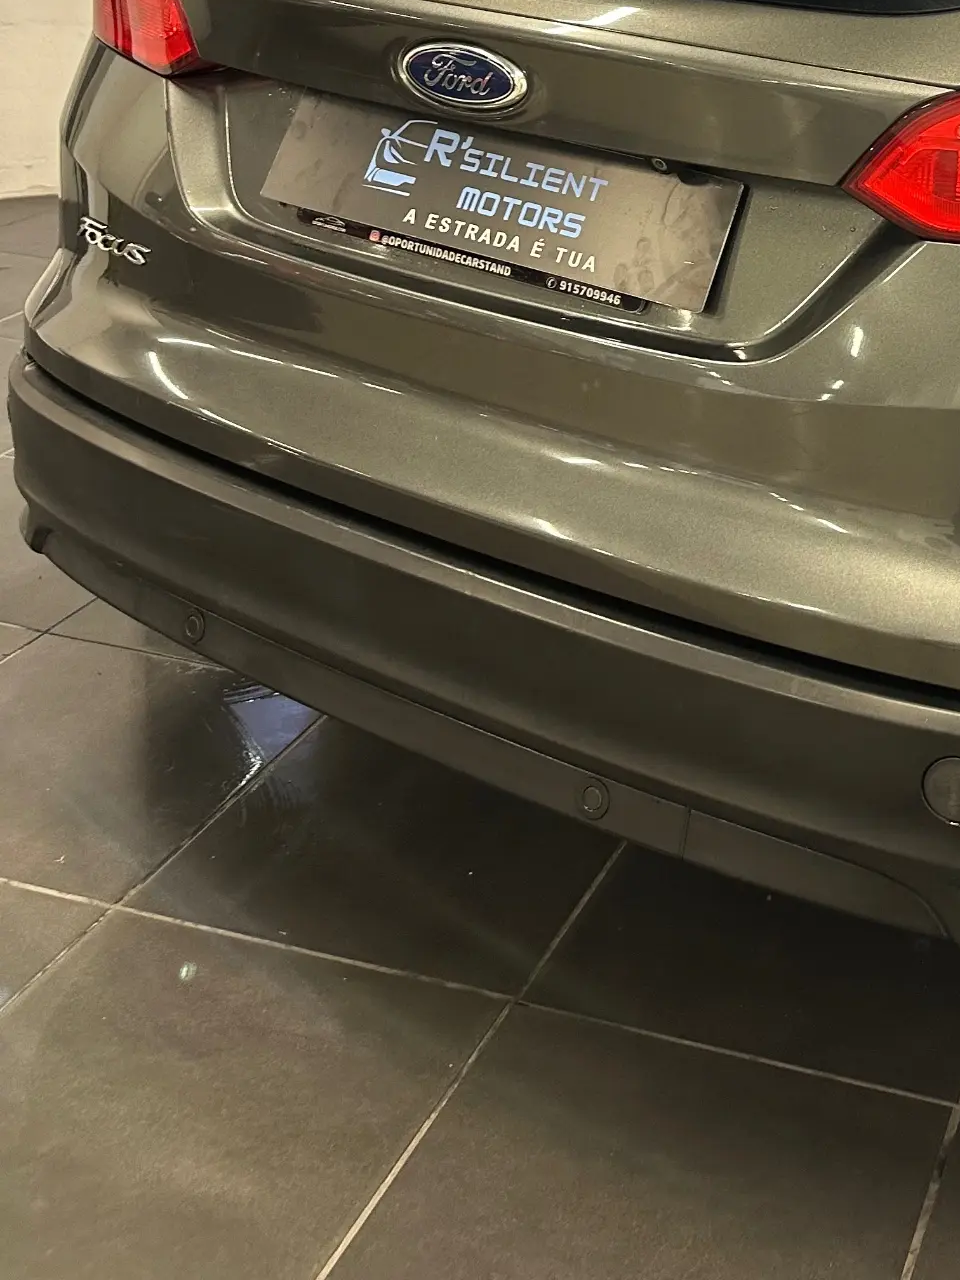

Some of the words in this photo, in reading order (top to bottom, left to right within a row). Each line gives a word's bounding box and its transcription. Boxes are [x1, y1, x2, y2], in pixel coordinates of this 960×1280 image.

[423, 52, 494, 96] Ford
[456, 186, 586, 239] MOTORS
[381, 235, 512, 277] @OPORTUNIDADECARSTAND
[403, 208, 416, 224] A
[424, 213, 520, 253] ESTRADA
[530, 238, 545, 258] É
[555, 247, 596, 272] TUA
[559, 280, 621, 305] 915709946
